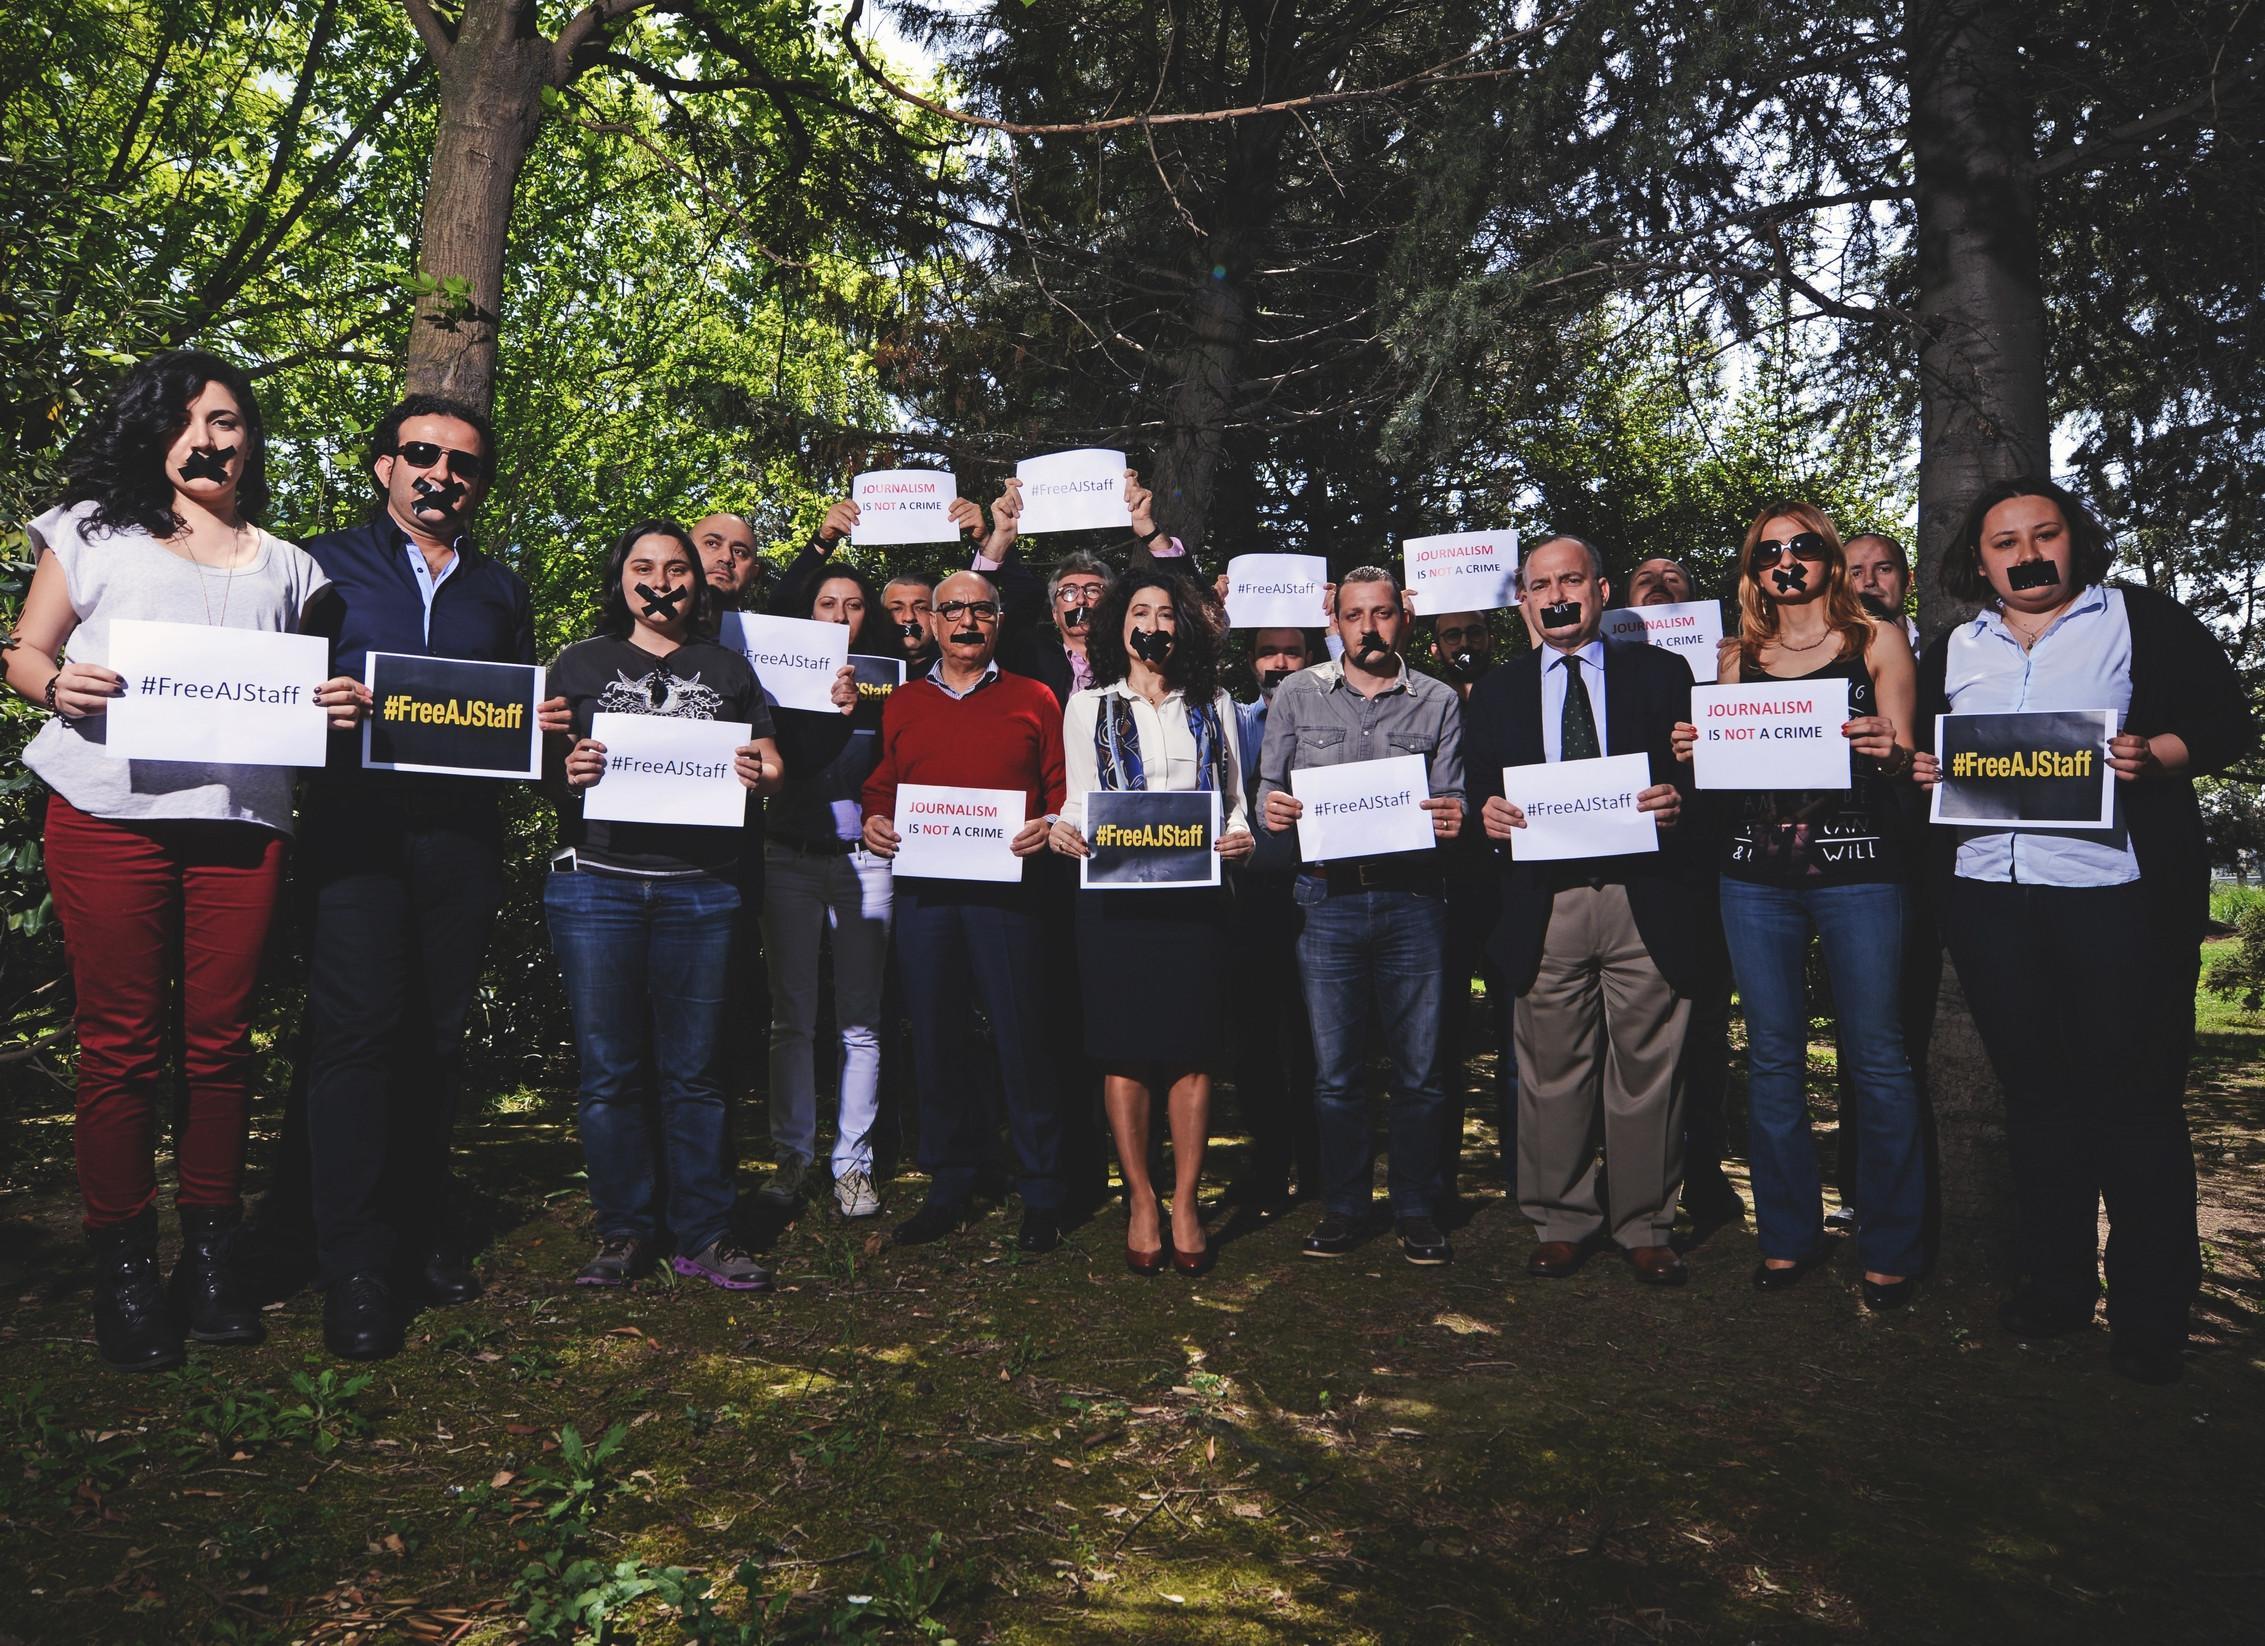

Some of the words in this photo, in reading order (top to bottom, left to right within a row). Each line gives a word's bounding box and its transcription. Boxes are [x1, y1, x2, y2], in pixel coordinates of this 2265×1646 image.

[862, 483, 936, 495] JOURNALISM
[1031, 478, 1114, 497] #FreeAJStaff
[862, 501, 872, 512] IS
[874, 501, 897, 512] NOT
[898, 501, 907, 511] A
[908, 500, 942, 511] CRIME
[1415, 544, 1495, 563] JOURNALISM
[1416, 567, 1427, 580] IS
[1429, 566, 1452, 578] NOT
[1455, 565, 1464, 575] A
[1465, 563, 1502, 575] CRIME
[1237, 582, 1316, 596] #FreeAJStaff
[1611, 616, 1696, 635] JOURNALISM
[1655, 638, 1665, 648] A
[1666, 634, 1705, 647] CRIME
[139, 676, 302, 705] #FreeAJStaff
[383, 694, 523, 730] #FreeAJStaff
[1706, 699, 1814, 718] JOURNALISM
[1708, 729, 1721, 742] IS
[1724, 728, 1758, 741] NOT
[1759, 727, 1771, 740] A
[1773, 725, 1825, 740] CRIME
[610, 755, 729, 780] #FreeAJStaff
[1952, 750, 2093, 778] #FreeAJStaff
[908, 801, 998, 818] JOURNALISM
[1313, 790, 1411, 818] #FreeAJStaff
[1526, 792, 1632, 818] #FreeAJStaff
[908, 823, 920, 834] IS
[922, 823, 950, 836] NOT
[951, 825, 962, 837] A
[964, 826, 1005, 840] CRIME
[1095, 823, 1204, 848] #FreeAJStaff
[1822, 841, 1876, 863] WILL
